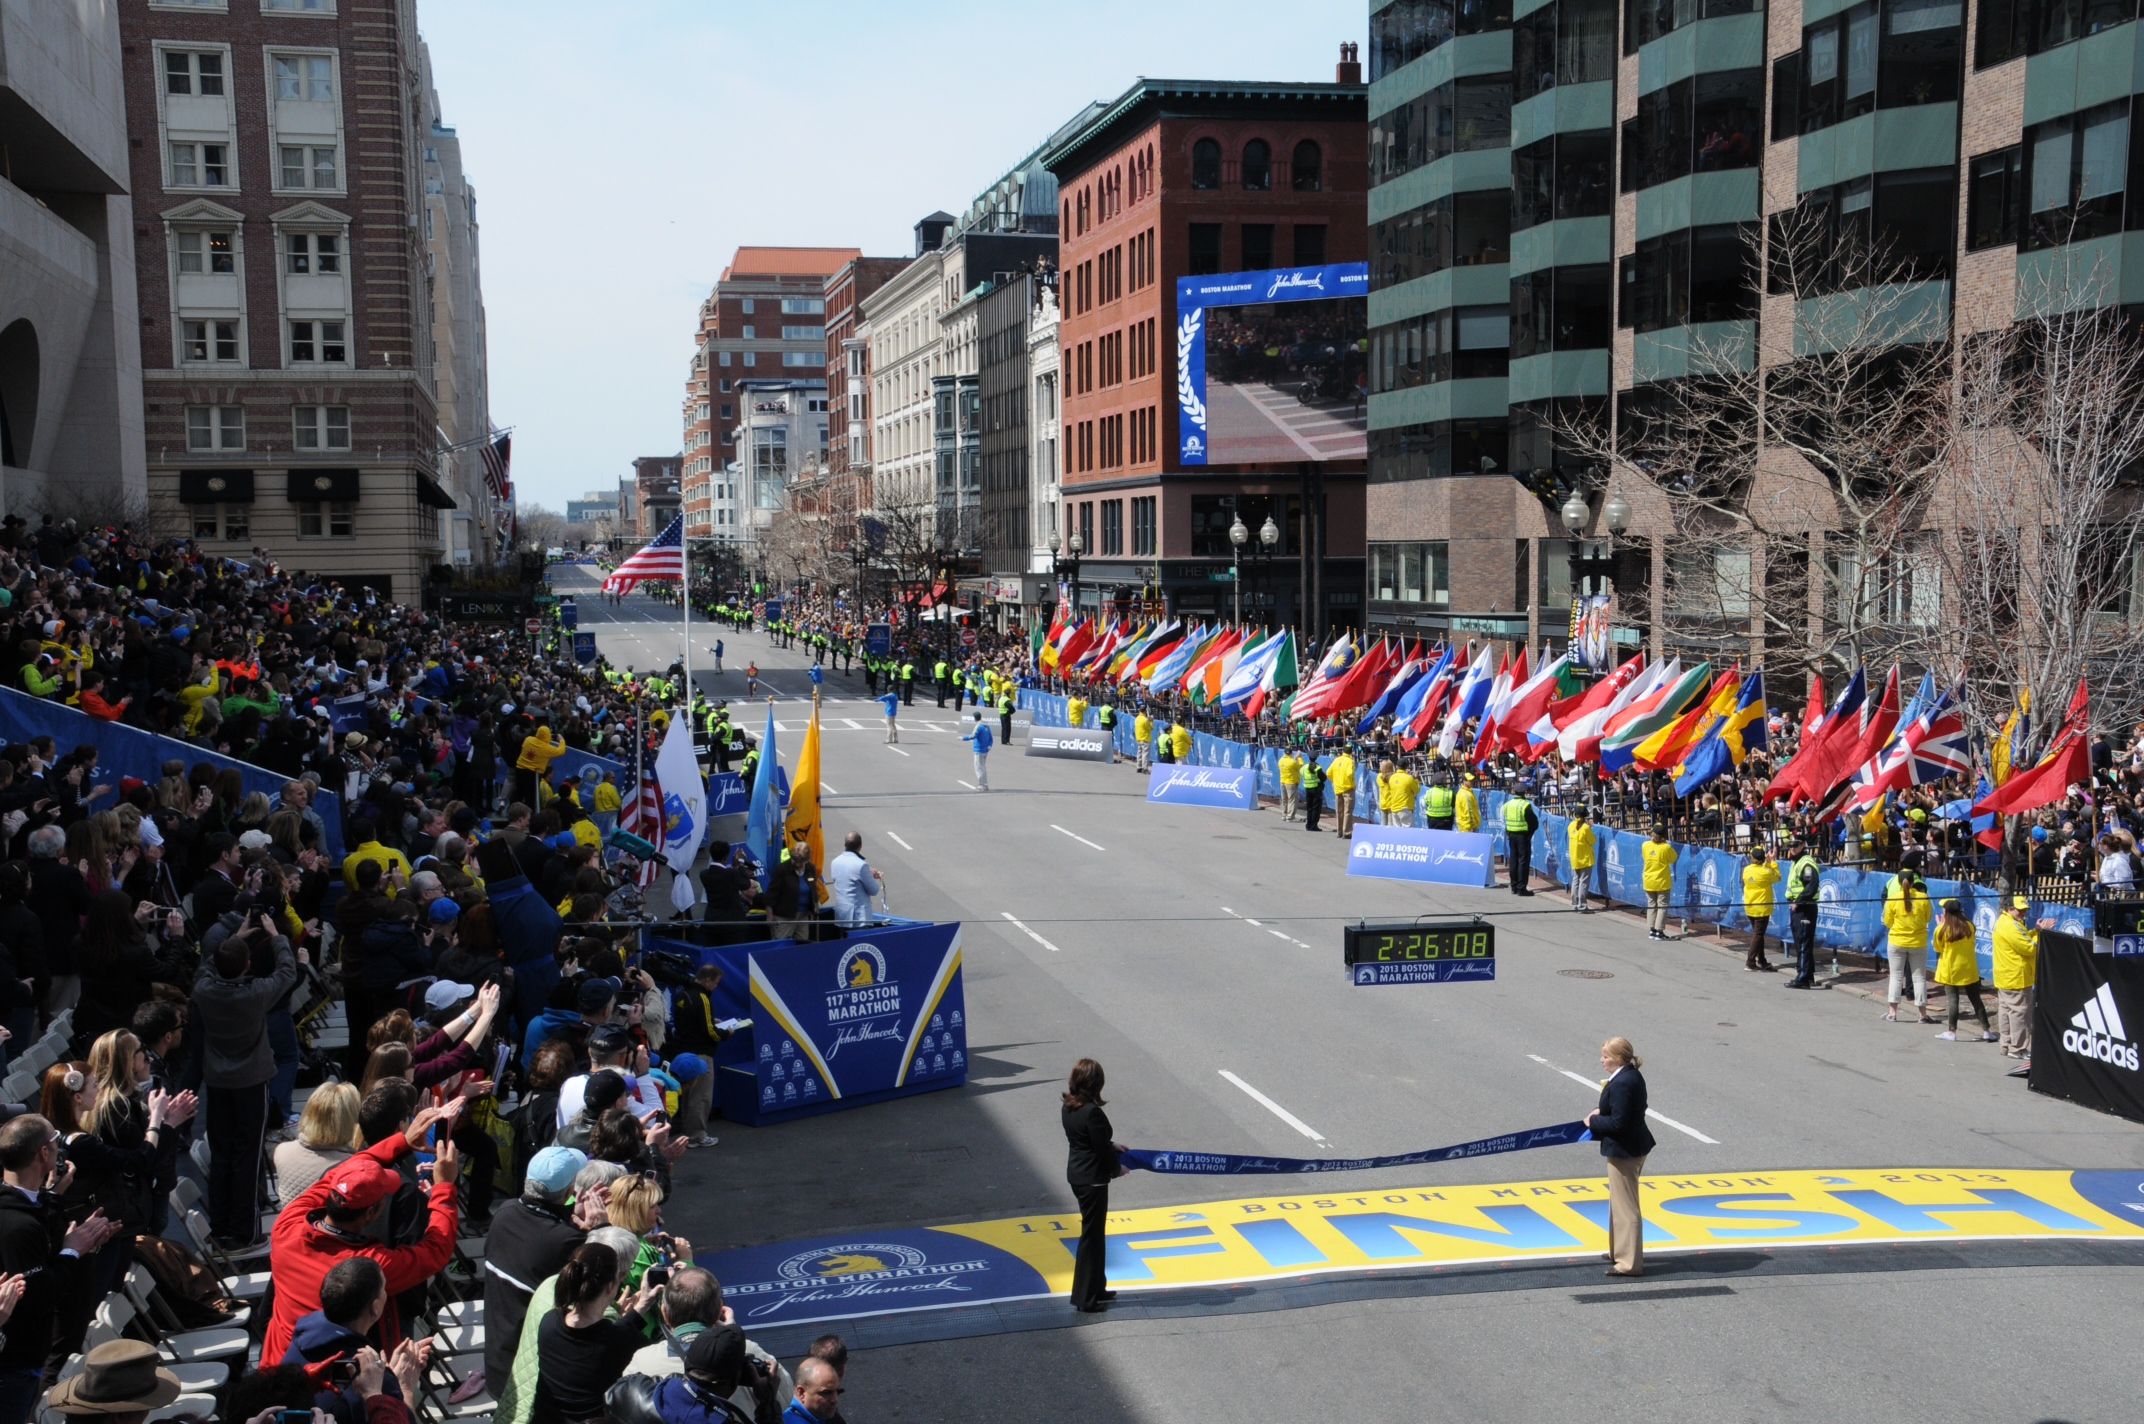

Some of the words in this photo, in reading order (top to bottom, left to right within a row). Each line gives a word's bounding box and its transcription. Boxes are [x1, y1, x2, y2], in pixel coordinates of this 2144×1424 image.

[1222, 284, 1252, 292] MARATHON
[1060, 738, 1102, 752] adidas
[1376, 843, 1394, 852] 2013
[1396, 844, 1429, 854] BOSTON
[1374, 852, 1428, 863] MARATHON
[1378, 933, 1487, 961] 2:26:08
[1380, 965, 1398, 974] 2013
[1401, 963, 1435, 973] BOSTON
[1380, 972, 1435, 982] MARATHON
[851, 985, 899, 1003] BOSTON
[828, 998, 901, 1021] MARATHON
[2062, 1029, 2140, 1071] adidas
[1174, 1154, 1192, 1163] 2013
[1195, 1155, 1227, 1164] BOSTON
[1174, 1163, 1226, 1172] MARATHON
[1240, 1192, 1448, 1214] BOSTON
[1489, 1176, 1772, 1199] MARTHON
[1879, 1172, 2007, 1184] 2013
[1059, 1188, 2105, 1281] FINISH
[721, 1277, 827, 1296] BOSTON
[839, 1260, 986, 1284] MARATHON
